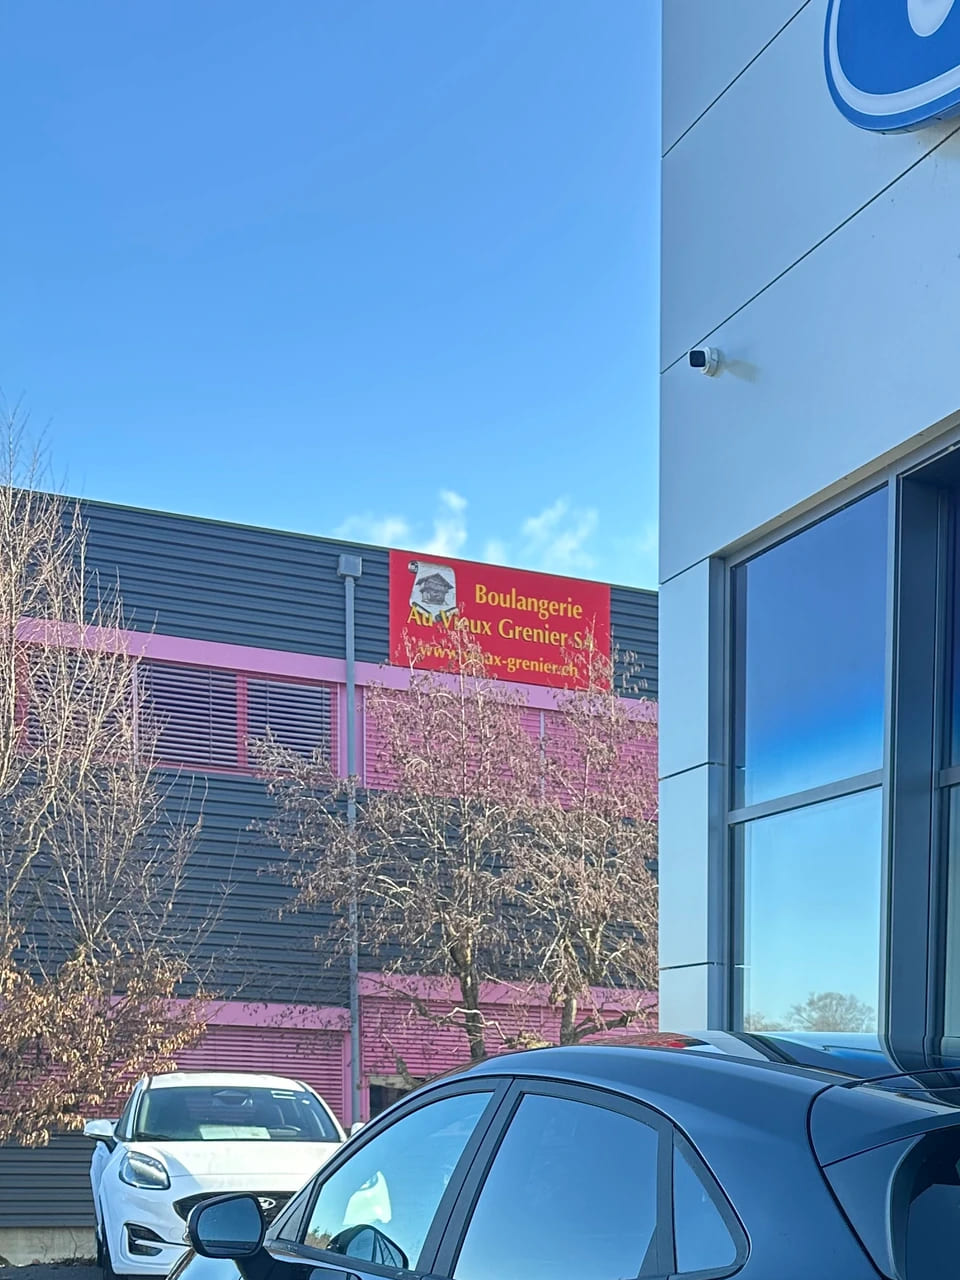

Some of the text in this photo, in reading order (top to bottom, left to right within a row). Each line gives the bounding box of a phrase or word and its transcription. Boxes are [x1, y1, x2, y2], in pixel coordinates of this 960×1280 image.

[475, 584, 583, 620] Boulangerie
[408, 606, 433, 627] Au
[498, 619, 569, 648] Grenier
